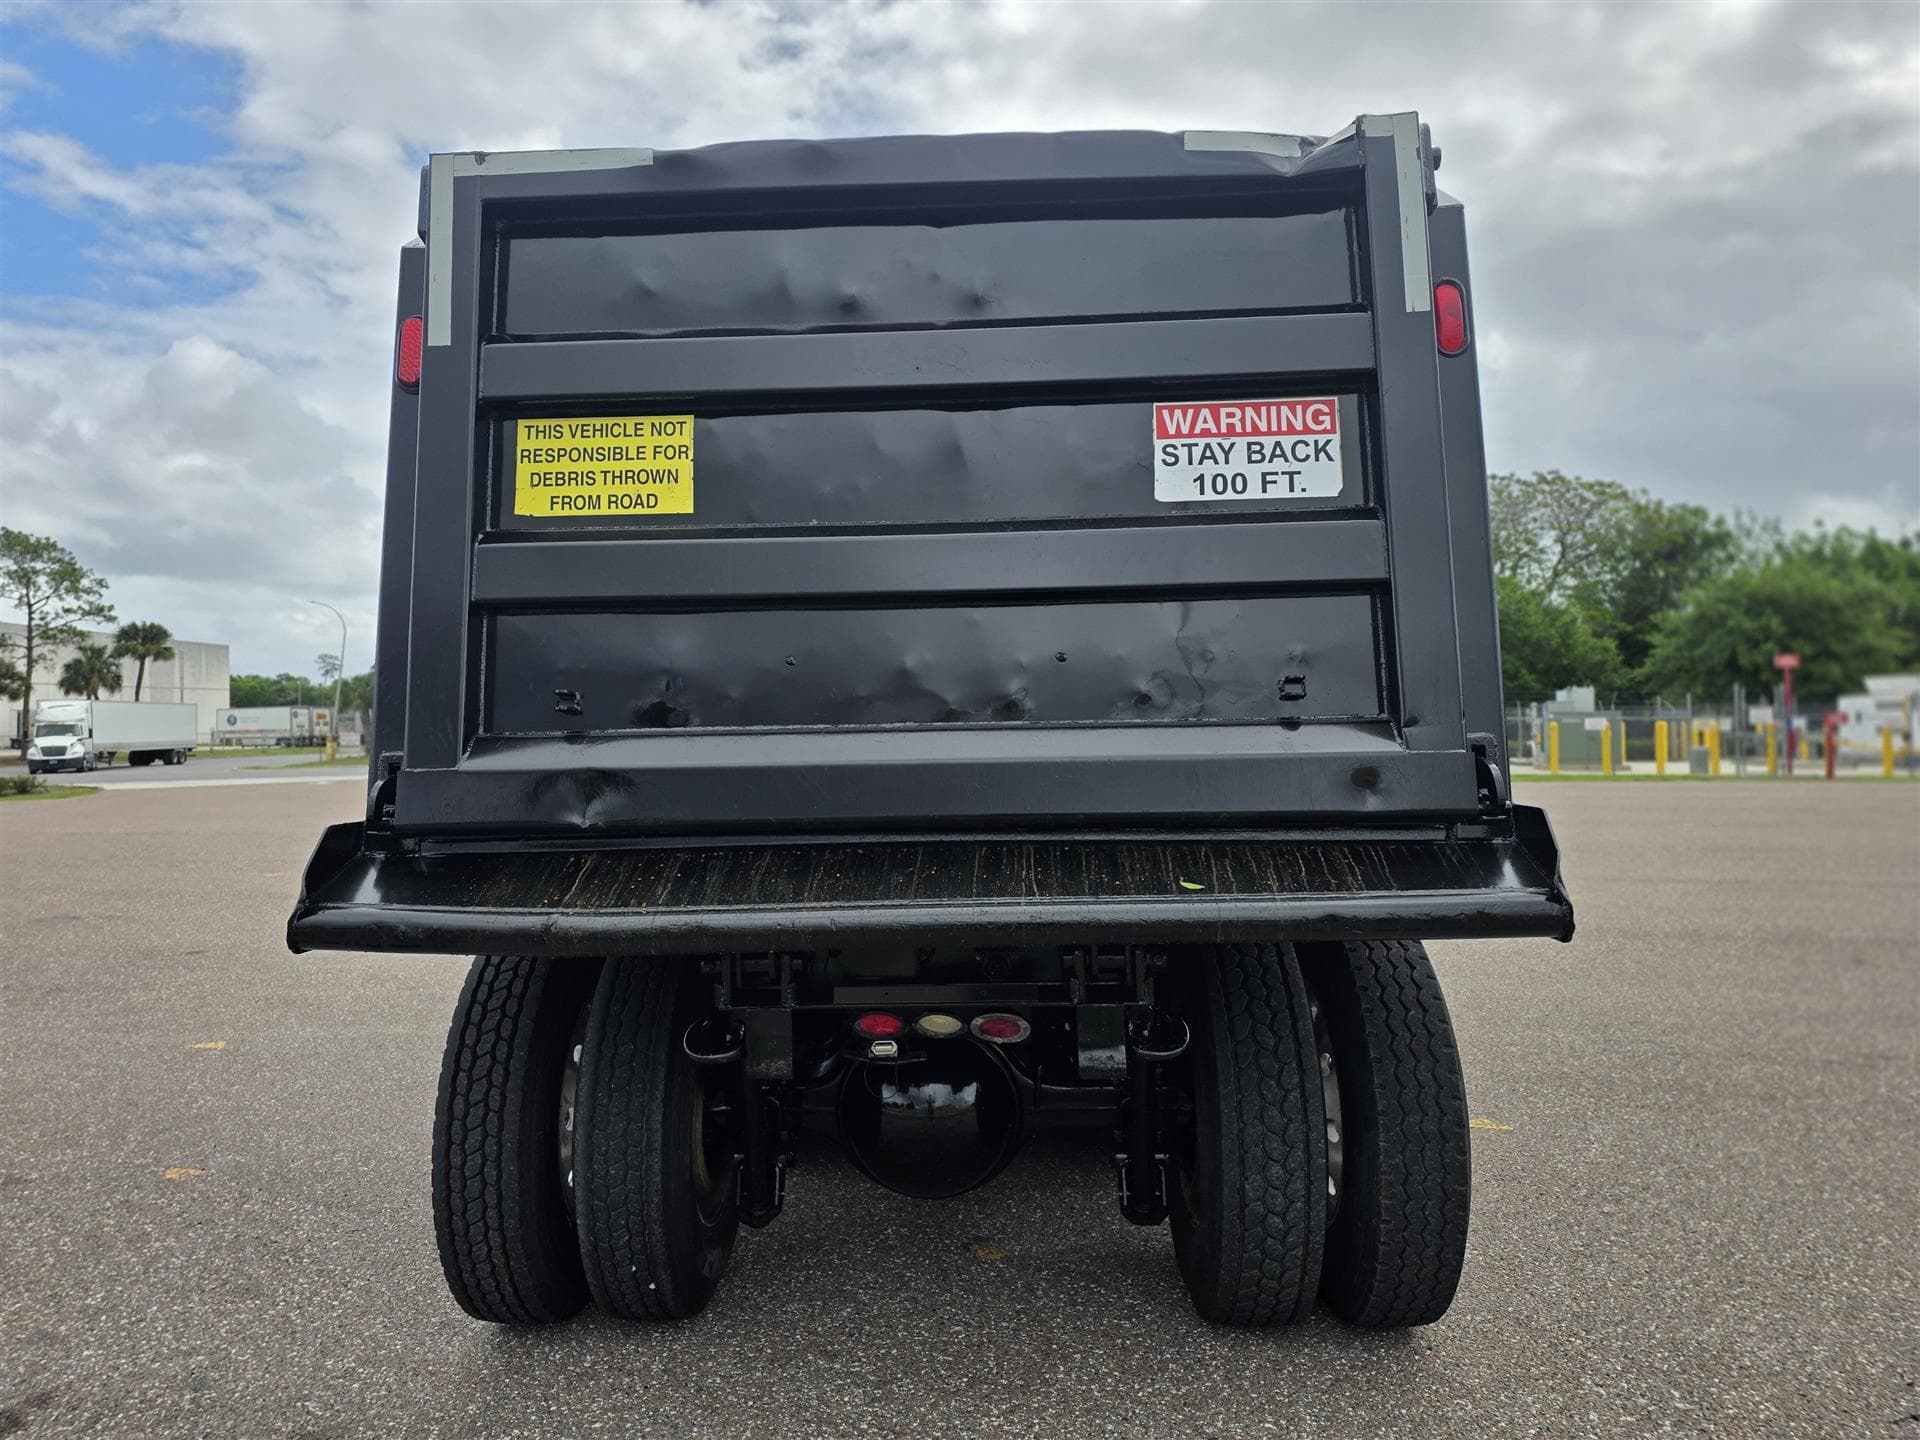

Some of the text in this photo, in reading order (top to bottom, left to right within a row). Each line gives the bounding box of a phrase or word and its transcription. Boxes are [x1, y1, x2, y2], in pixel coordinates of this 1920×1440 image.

[1162, 403, 1331, 434] WARNING
[524, 421, 687, 440] THIS VEHICLE NOT
[520, 445, 689, 464] RESPONSIBLE FOR
[1161, 439, 1335, 466] STAY BACK
[530, 469, 679, 488] DEBRIS THROWN
[1193, 470, 1307, 495] 100 FT.
[550, 493, 659, 511] FROM ROAD
